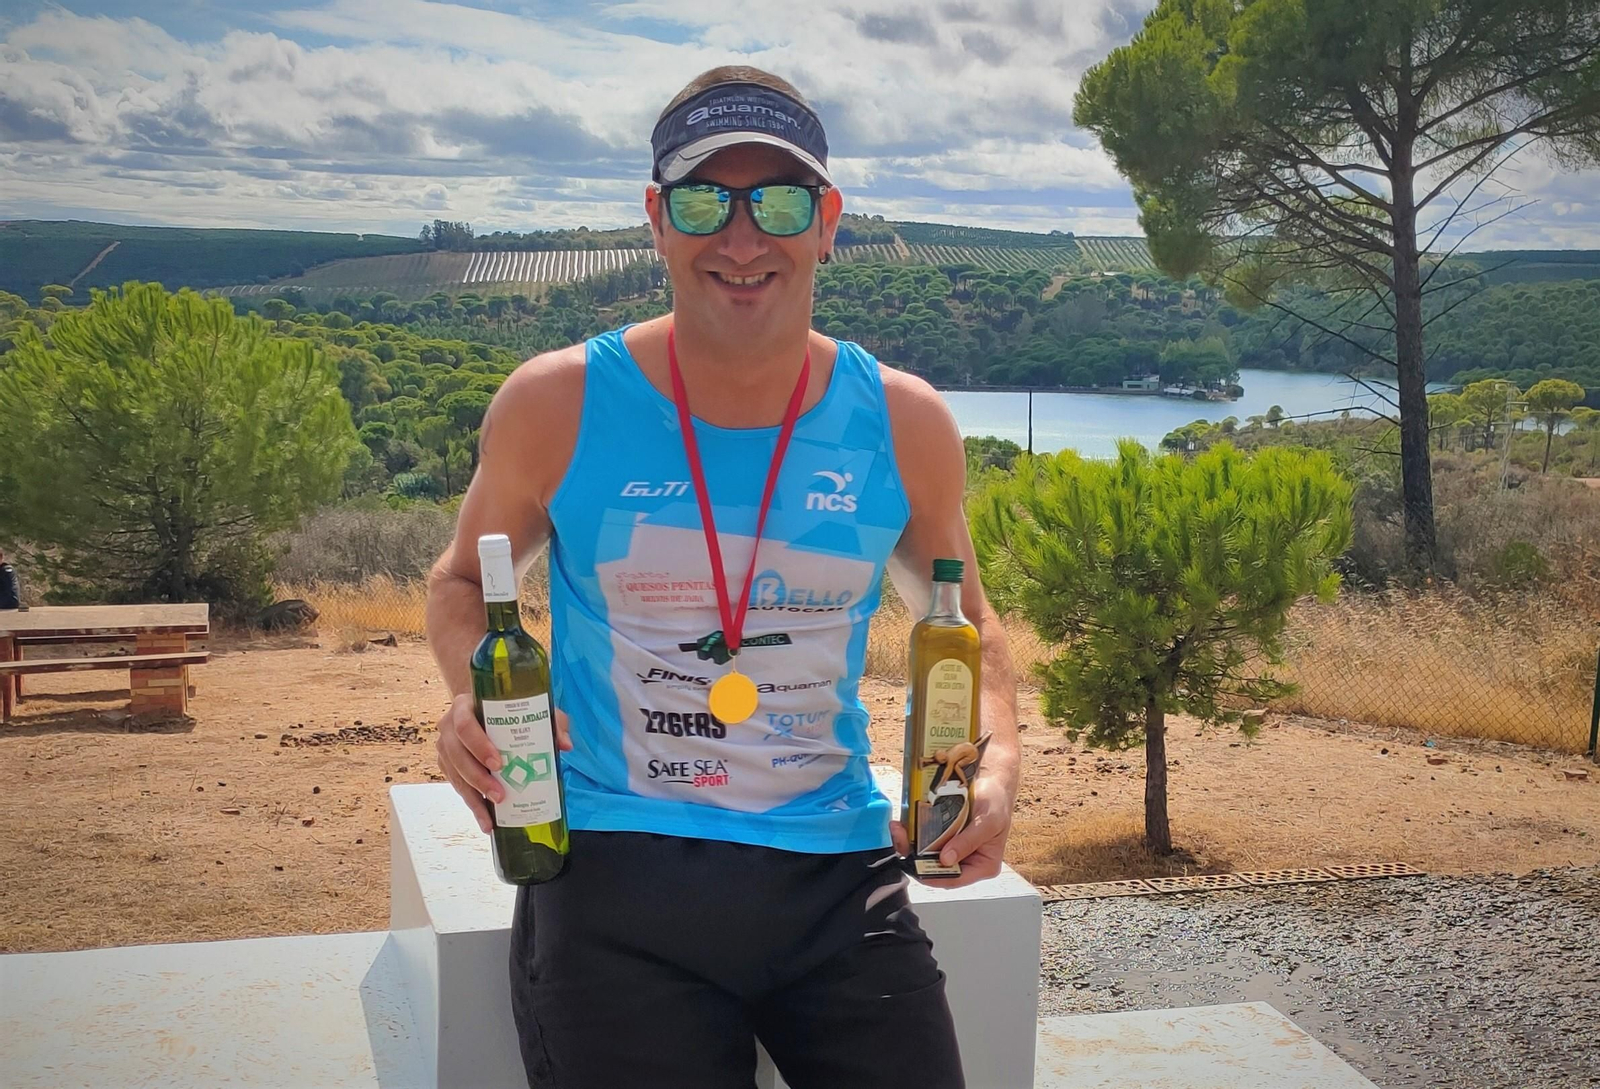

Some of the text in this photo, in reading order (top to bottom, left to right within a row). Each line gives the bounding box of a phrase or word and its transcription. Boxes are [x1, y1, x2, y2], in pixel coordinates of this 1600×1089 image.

[706, 115, 742, 128] SWIMMING
[744, 115, 766, 128] SINCE
[806, 492, 858, 513] ncs
[625, 582, 670, 592] QUESOS
[647, 668, 708, 686] FINIS
[756, 680, 832, 693] aquaman
[486, 716, 520, 726] CONDADO
[639, 708, 726, 739] 226ERS
[647, 759, 728, 778] SAFE SEA
[693, 775, 729, 787] SPORT
